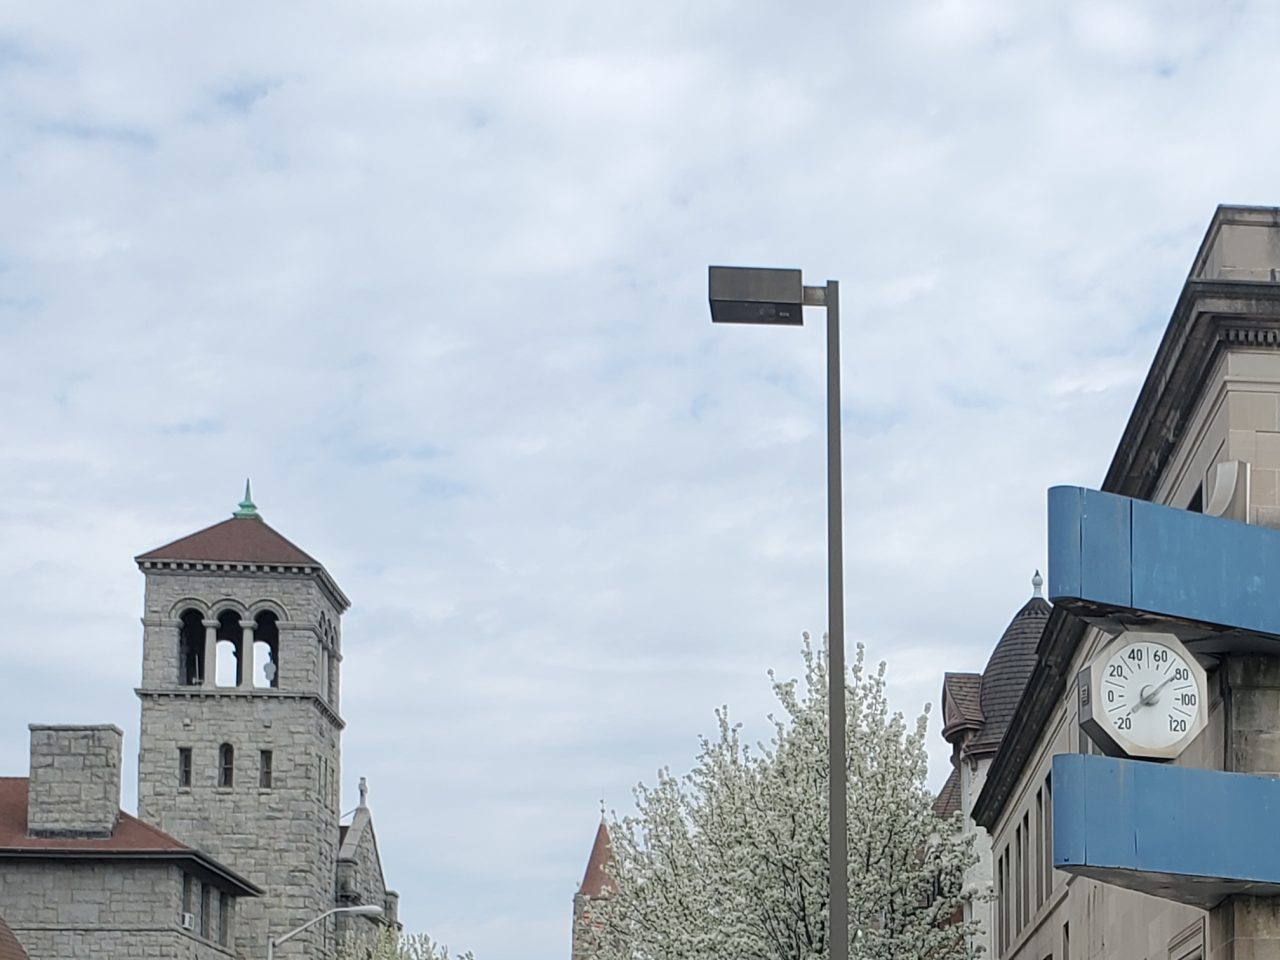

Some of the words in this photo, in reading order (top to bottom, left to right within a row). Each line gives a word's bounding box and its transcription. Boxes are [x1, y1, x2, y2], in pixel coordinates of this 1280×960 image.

[1128, 648, 1143, 662] 40
[1153, 650, 1168, 663] 60
[1109, 665, 1123, 678] 20
[1175, 668, 1189, 681] 80
[1107, 690, 1115, 703] 0
[1181, 693, 1196, 706] 100
[1169, 719, 1187, 732] 120
